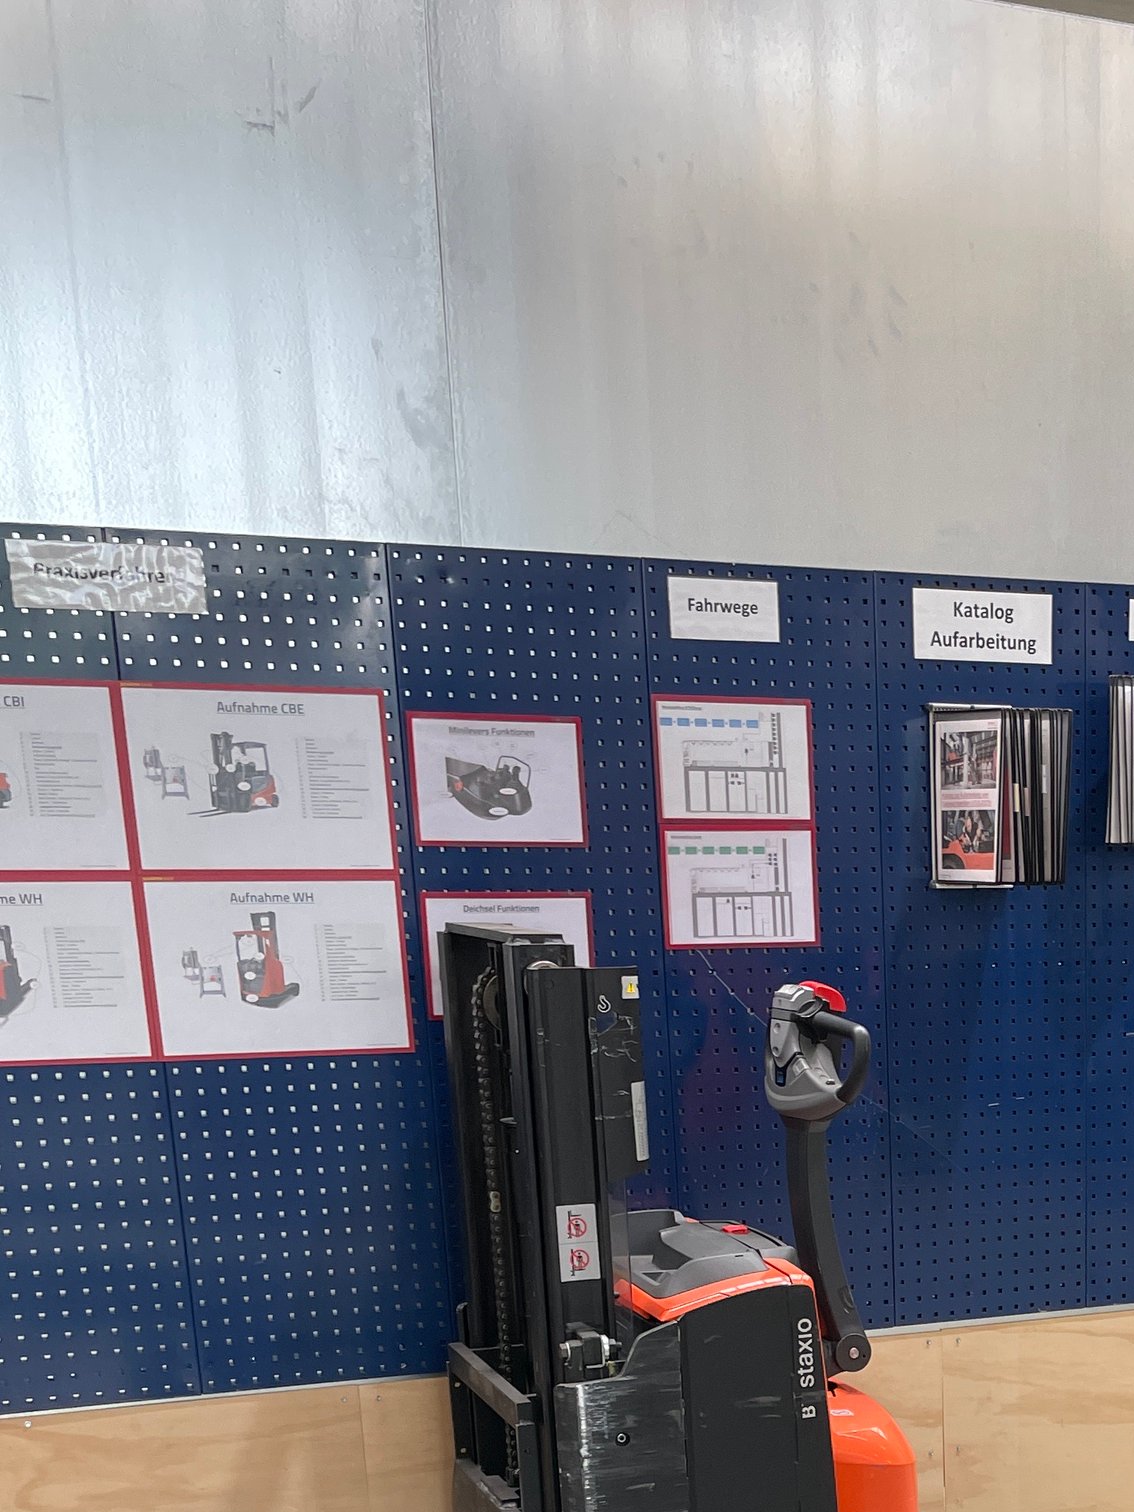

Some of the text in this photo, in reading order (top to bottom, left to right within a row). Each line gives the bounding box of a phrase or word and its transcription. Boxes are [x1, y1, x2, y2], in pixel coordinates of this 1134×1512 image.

[687, 597, 759, 618] Fahrwege
[953, 601, 1014, 624] Katalog
[930, 631, 1037, 655] Aufarbeitung
[3, 695, 25, 707] CBI
[217, 701, 305, 715] Aufnahme CBE
[18, 893, 43, 904] WH
[230, 892, 314, 903] Aufnahme WH
[797, 1318, 815, 1388] staxio
